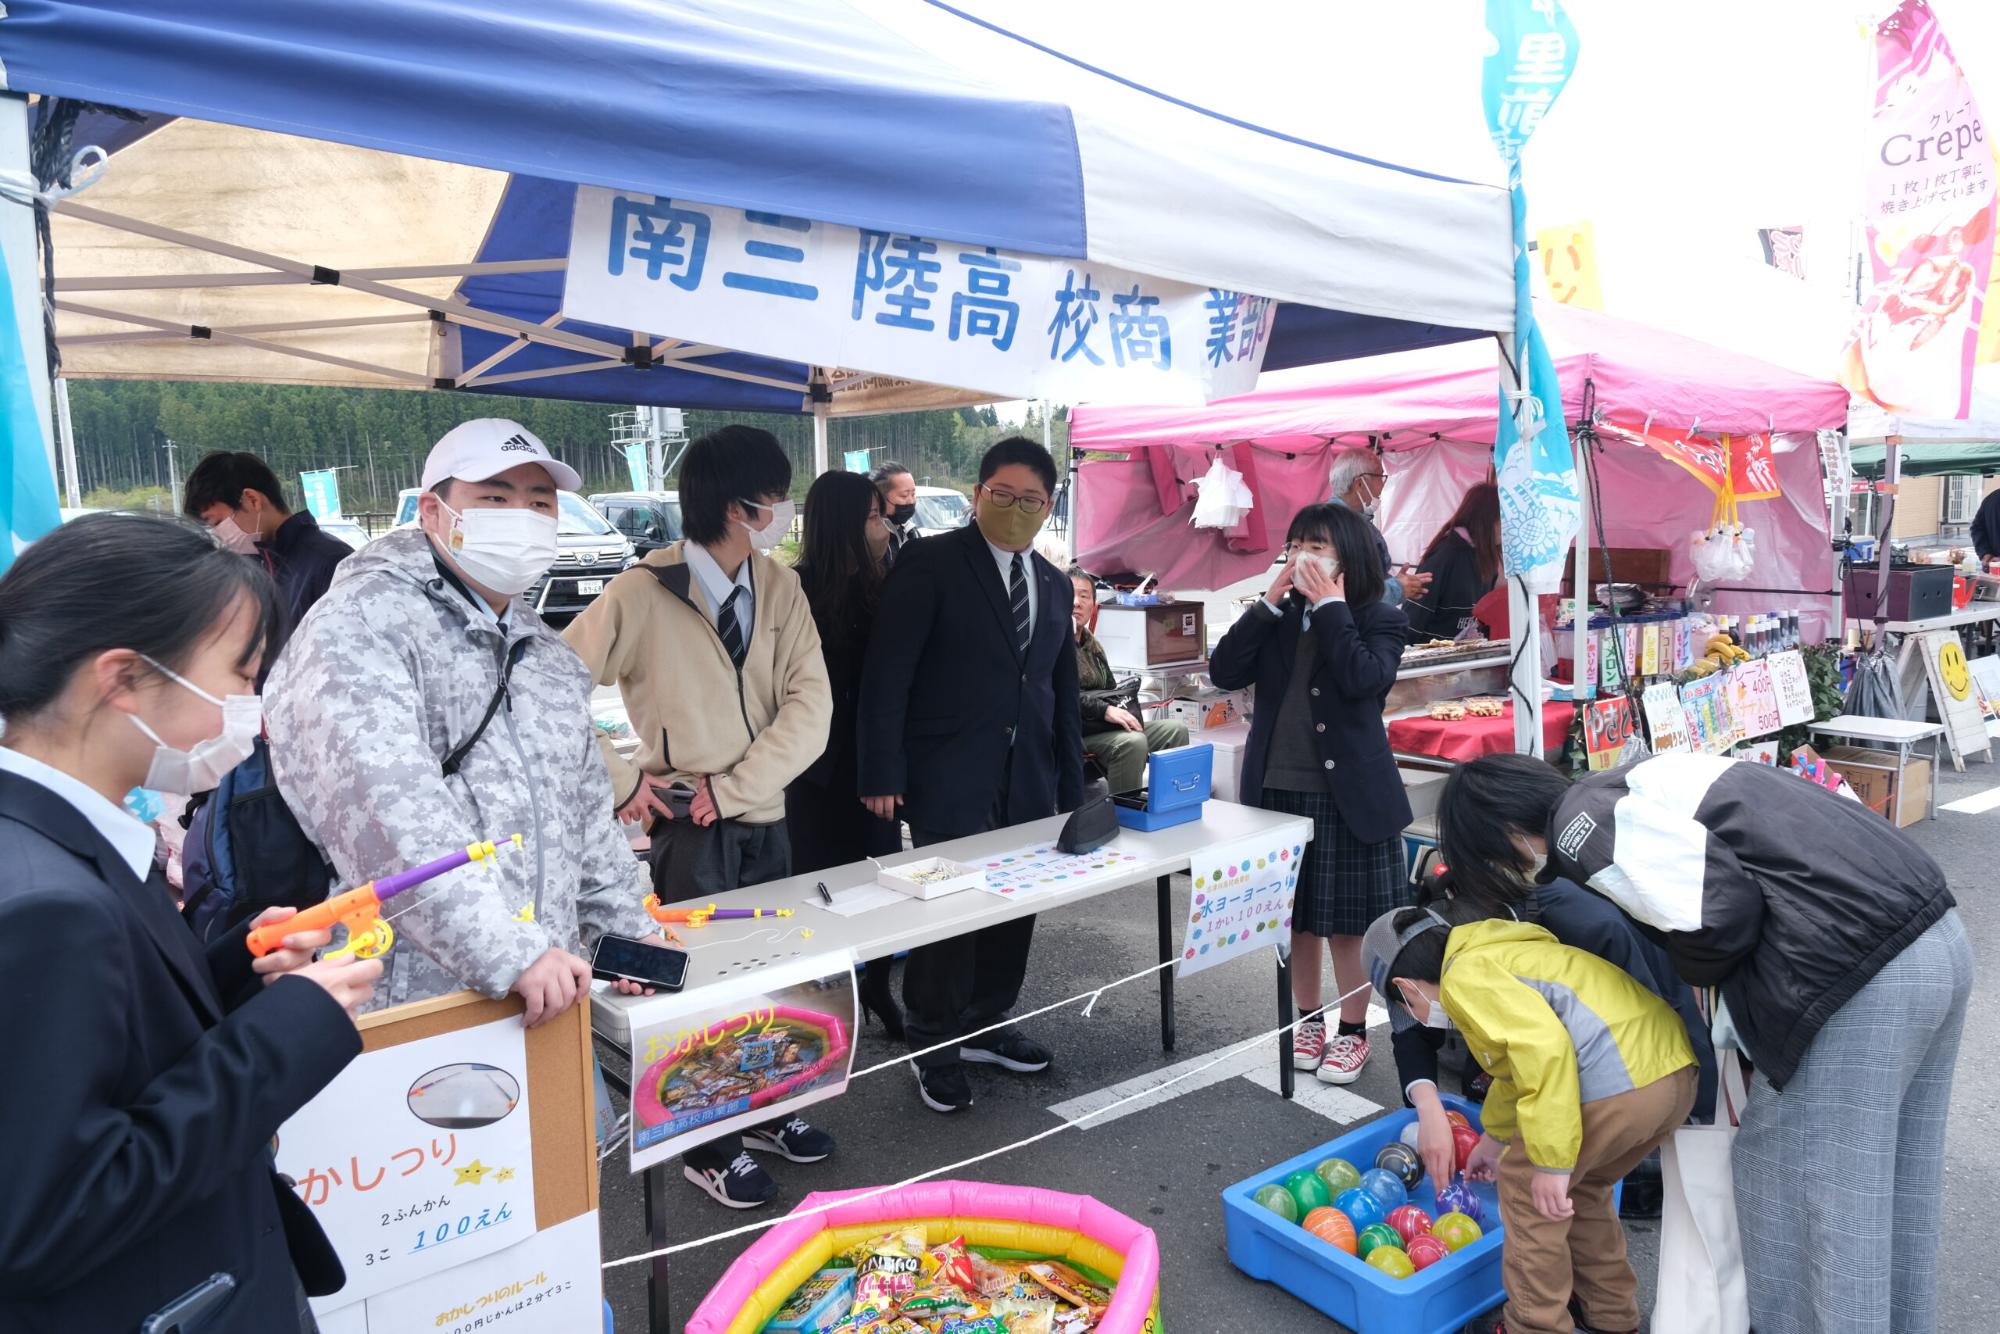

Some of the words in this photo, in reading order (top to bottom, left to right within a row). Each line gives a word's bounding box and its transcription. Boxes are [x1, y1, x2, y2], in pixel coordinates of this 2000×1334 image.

[1880, 119, 1983, 166] Crepe
[1880, 179, 1988, 214] 焼き上げています
[607, 195, 1272, 371] 南三陸高校商業部
[500, 444, 538, 455] adidas
[1605, 648, 1617, 682] メロン
[1587, 702, 1634, 748] やきと
[1560, 816, 1585, 849] ADORABLE
[1571, 829, 1586, 848] GIRLS
[1201, 873, 1296, 919] 水ヨーヨーつり
[643, 1004, 775, 1063] おかしつり
[381, 1194, 451, 1226] 2ふんかん
[365, 1248, 392, 1266] 3こ
[413, 1201, 513, 1250] 100えん
[435, 1270, 549, 1328] おかしつりのルール
